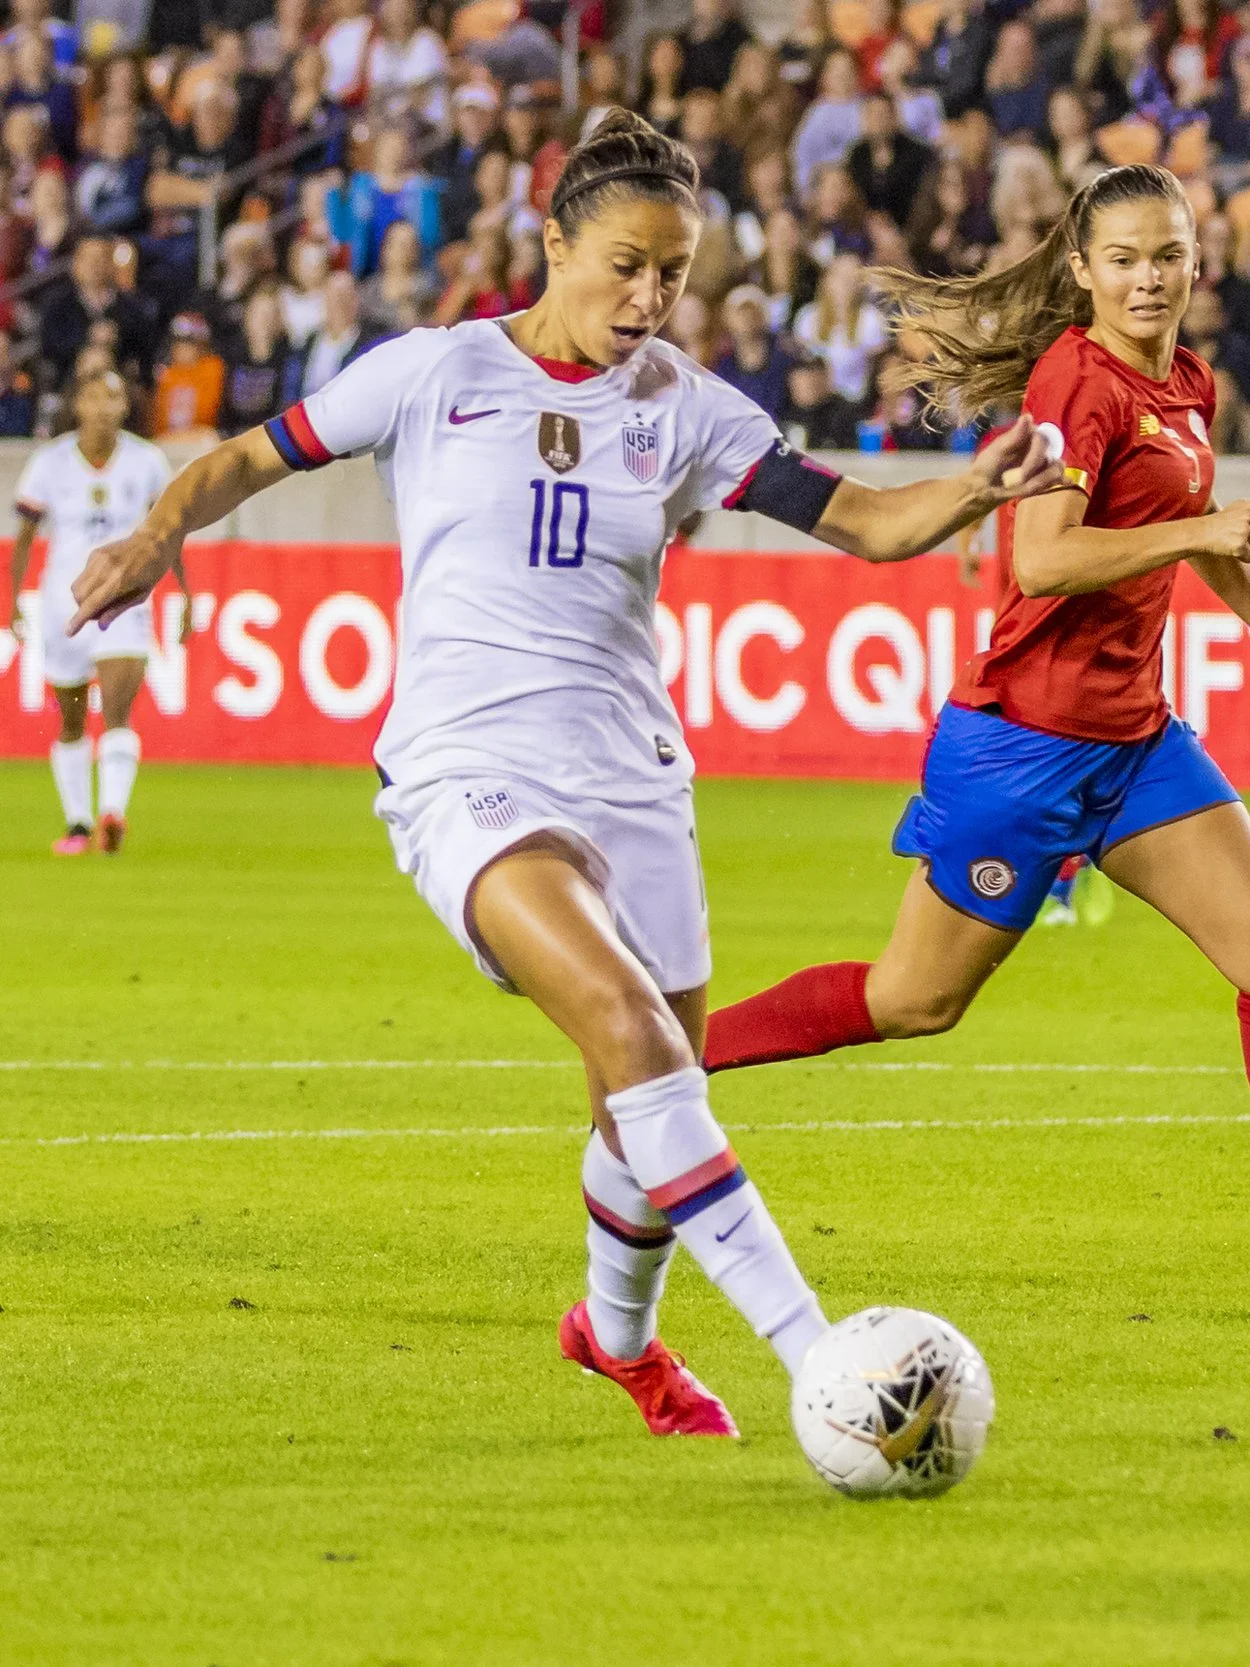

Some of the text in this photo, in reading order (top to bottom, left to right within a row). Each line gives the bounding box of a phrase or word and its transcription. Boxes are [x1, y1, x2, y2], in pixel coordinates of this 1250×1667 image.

[625, 430, 657, 453] USA
[528, 478, 590, 569] 10
[471, 791, 508, 811] USA
